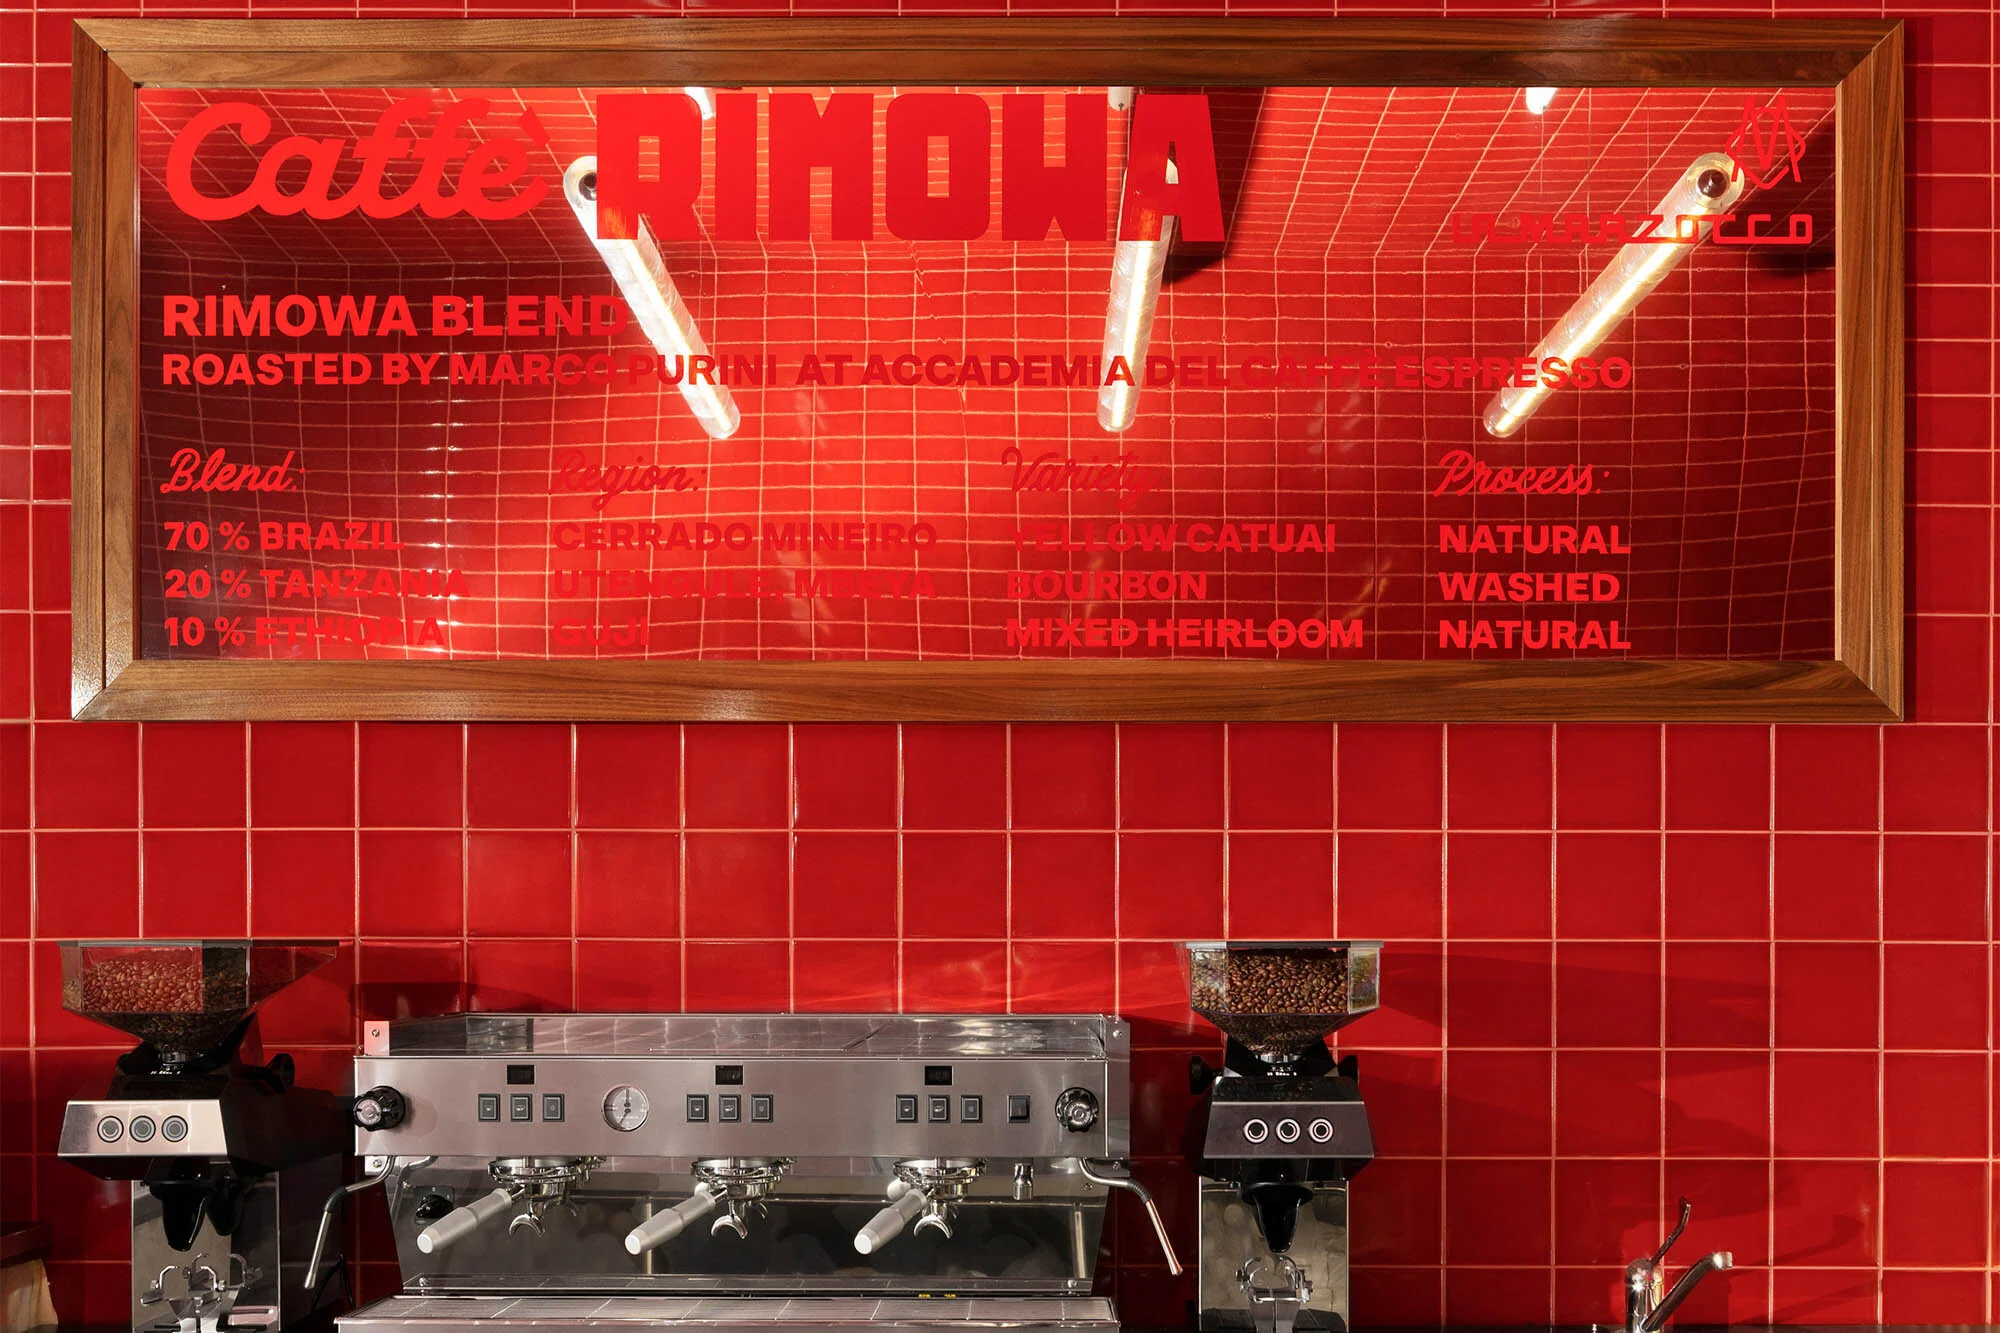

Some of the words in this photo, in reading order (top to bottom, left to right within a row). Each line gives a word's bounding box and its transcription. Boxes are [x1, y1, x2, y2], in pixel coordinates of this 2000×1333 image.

[596, 93, 1225, 242] RIMOWA
[1453, 213, 1496, 243] LA
[1520, 213, 1813, 244] MARZOCCO
[163, 295, 417, 337] RIMOWA
[432, 295, 628, 337] BLEND
[163, 353, 372, 386] ROASTED
[383, 353, 443, 385] BY
[449, 353, 617, 386] MARCO
[629, 354, 777, 386] PURINI
[796, 355, 852, 386] AT
[862, 355, 1136, 387] ACCADEMIA
[1146, 356, 1230, 387] DEL
[1396, 356, 1632, 389] ESPRESSO
[1433, 449, 1610, 497] Process:
[164, 521, 209, 551] 70
[219, 521, 250, 551] %
[259, 521, 405, 551] BRAZIL
[553, 522, 753, 552] CERRADO
[763, 522, 938, 552] MINEIRO
[1004, 523, 1179, 553] YELLOW
[1186, 523, 1336, 553] CATUAI
[1439, 524, 1632, 554] NATURAL
[165, 569, 212, 599] 20
[221, 569, 252, 599] %
[259, 569, 471, 599] TANZANIA
[553, 569, 783, 604] UTENGULE,
[793, 570, 937, 599] MBEYA
[1006, 570, 1208, 601] BOURBON
[1438, 571, 1620, 602] WASHED
[165, 616, 206, 647] 10
[214, 616, 246, 646] %
[256, 616, 446, 647] ETHIOPIA
[552, 616, 649, 647] GUJI
[1005, 617, 1140, 648] MIXED
[1147, 618, 1364, 649] HEIRLOOM
[1439, 619, 1632, 650] NATURAL
